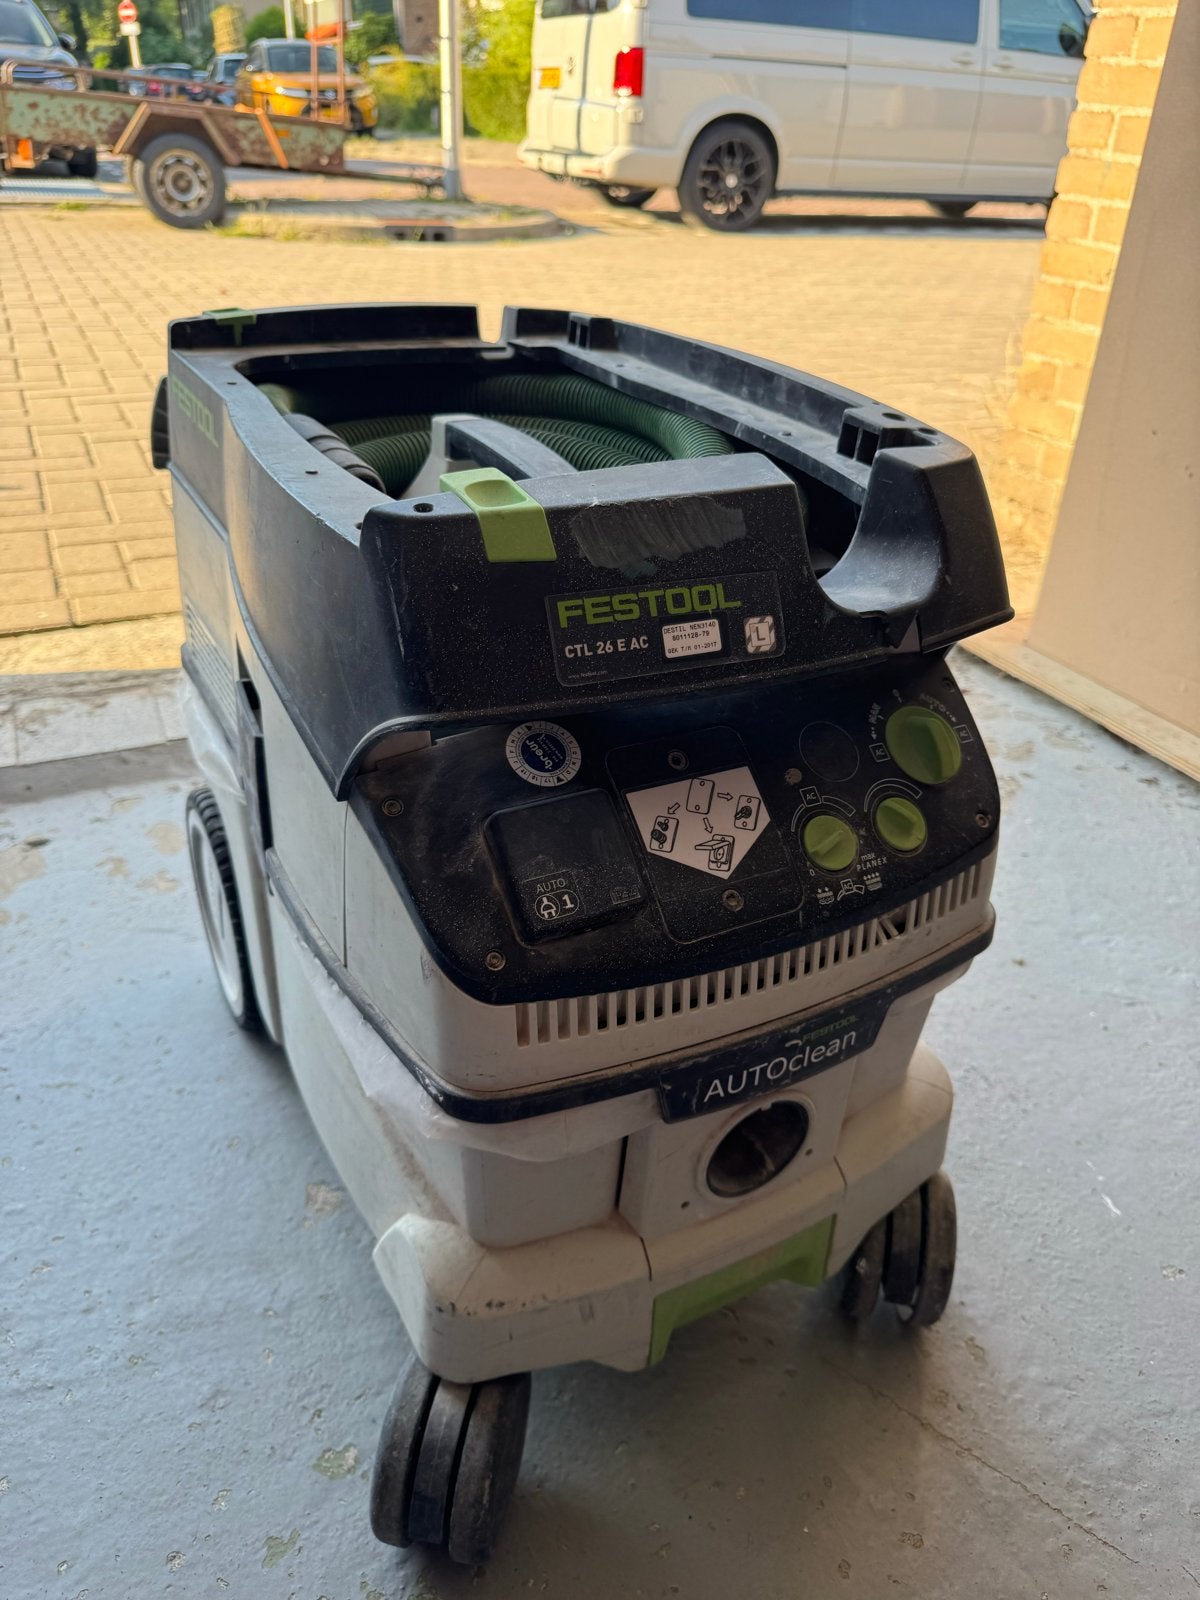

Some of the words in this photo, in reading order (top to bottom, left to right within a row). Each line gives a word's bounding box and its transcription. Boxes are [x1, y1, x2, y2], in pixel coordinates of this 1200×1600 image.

[557, 583, 742, 628] FESTOOL
[755, 626, 766, 642] L
[564, 643, 594, 658] CTL
[596, 640, 614, 654] 26
[617, 638, 627, 652] E
[630, 636, 649, 650] AC
[526, 739, 553, 770] breur
[806, 792, 817, 801] AC
[856, 855, 888, 872] PLANEX
[860, 852, 876, 862] max
[535, 878, 567, 894] AUTO
[562, 894, 575, 909] 1
[703, 1031, 857, 1103] AUTOclean
